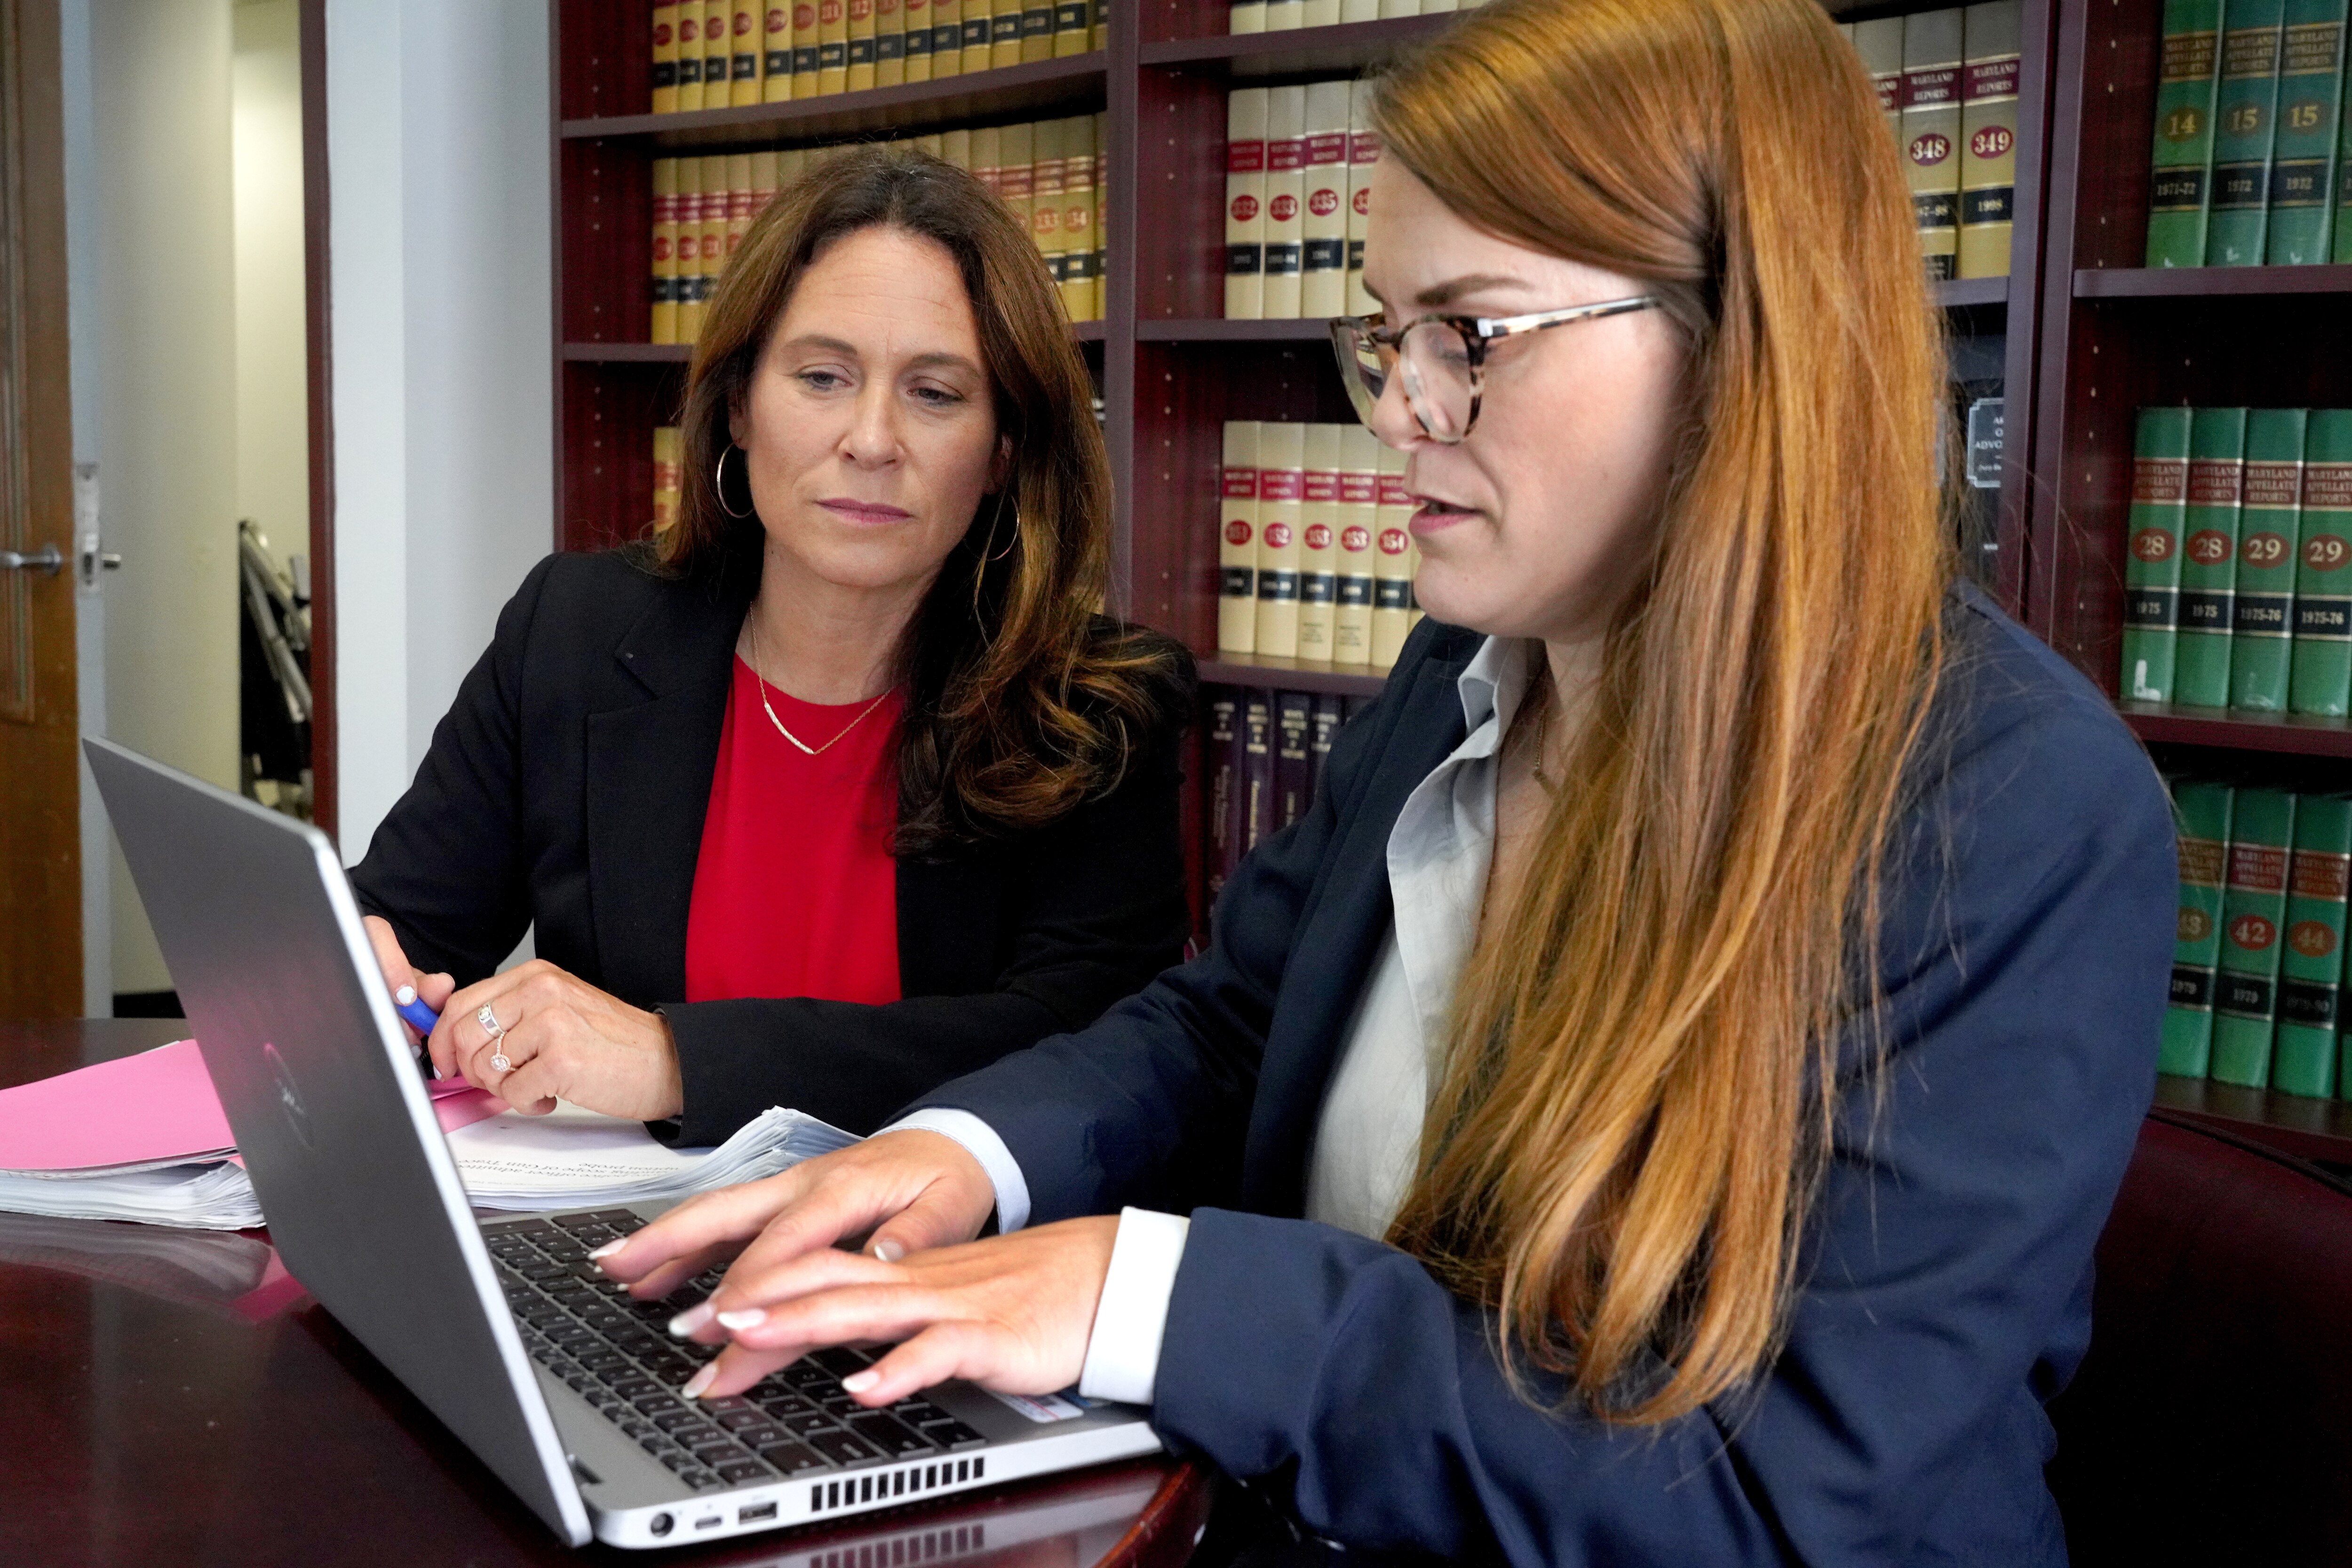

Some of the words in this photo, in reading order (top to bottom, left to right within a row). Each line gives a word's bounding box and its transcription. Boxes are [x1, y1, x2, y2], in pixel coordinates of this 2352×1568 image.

[2168, 113, 2196, 136] 14
[2232, 108, 2258, 132] 15
[2290, 104, 2318, 127] 15
[1912, 138, 1947, 160] 348
[1974, 131, 2011, 154] 349
[2247, 469, 2296, 479] MARYLAND
[2308, 470, 2352, 480] MARYLAN
[2246, 480, 2296, 490] APPELLATE
[2249, 492, 2290, 501] REPORTS
[2140, 535, 2166, 556] 28
[2195, 537, 2223, 558] 28
[2248, 538, 2282, 560] 29
[2309, 540, 2343, 562] 29
[2302, 610, 2345, 625] 1975-76
[2235, 922, 2266, 943] 42
[2297, 927, 2326, 949] 44
